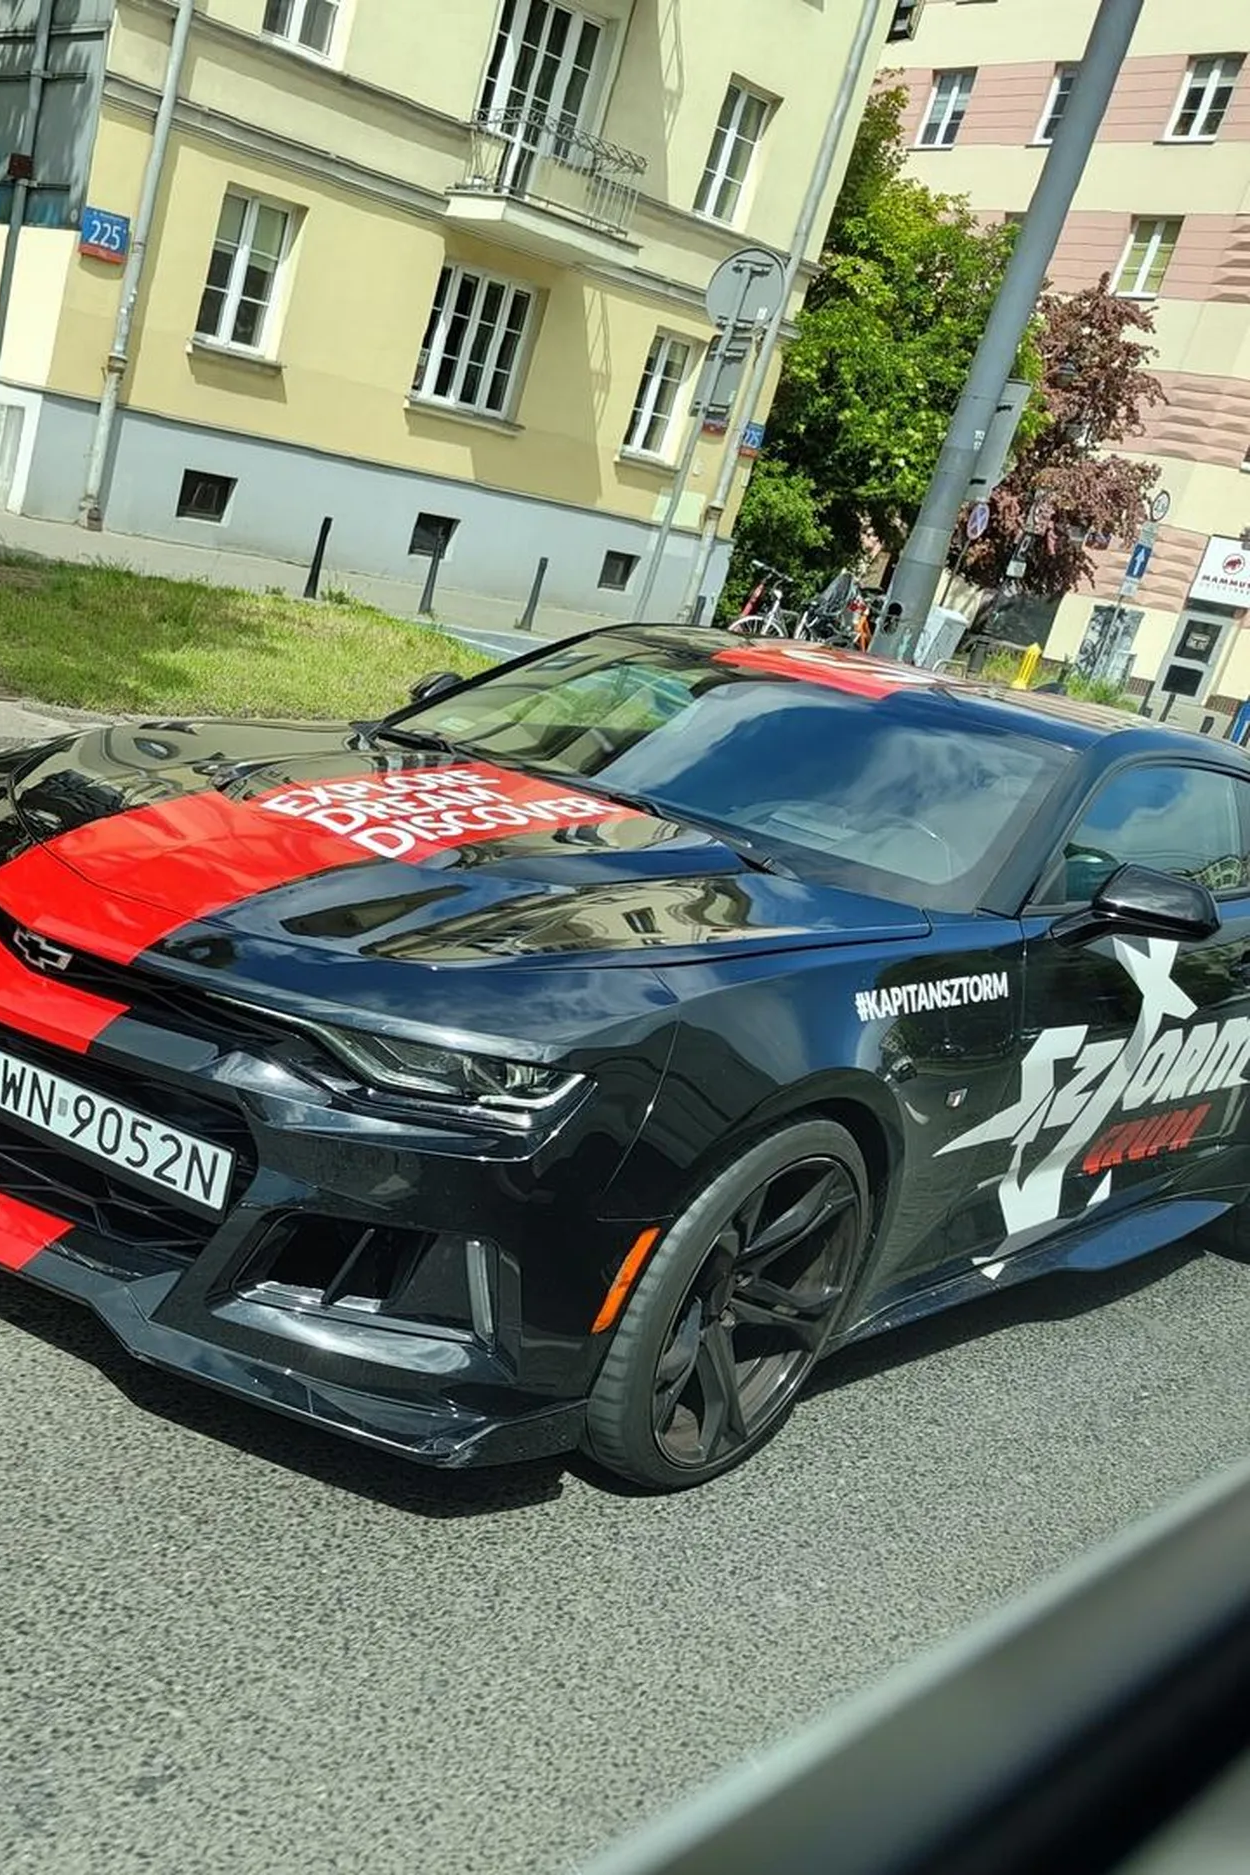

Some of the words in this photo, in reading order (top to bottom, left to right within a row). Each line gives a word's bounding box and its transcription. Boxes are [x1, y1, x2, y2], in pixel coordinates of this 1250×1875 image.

[89, 220, 121, 250] 225
[1202, 574, 1250, 590] MAMMU
[259, 769, 501, 817] EXPLORE
[305, 786, 513, 836] DREAM
[350, 797, 621, 859] DISCOVER
[855, 971, 1009, 1022] #KAPITANSZTORM
[1, 1058, 56, 1126] WN
[68, 1094, 220, 1201] 9052N
